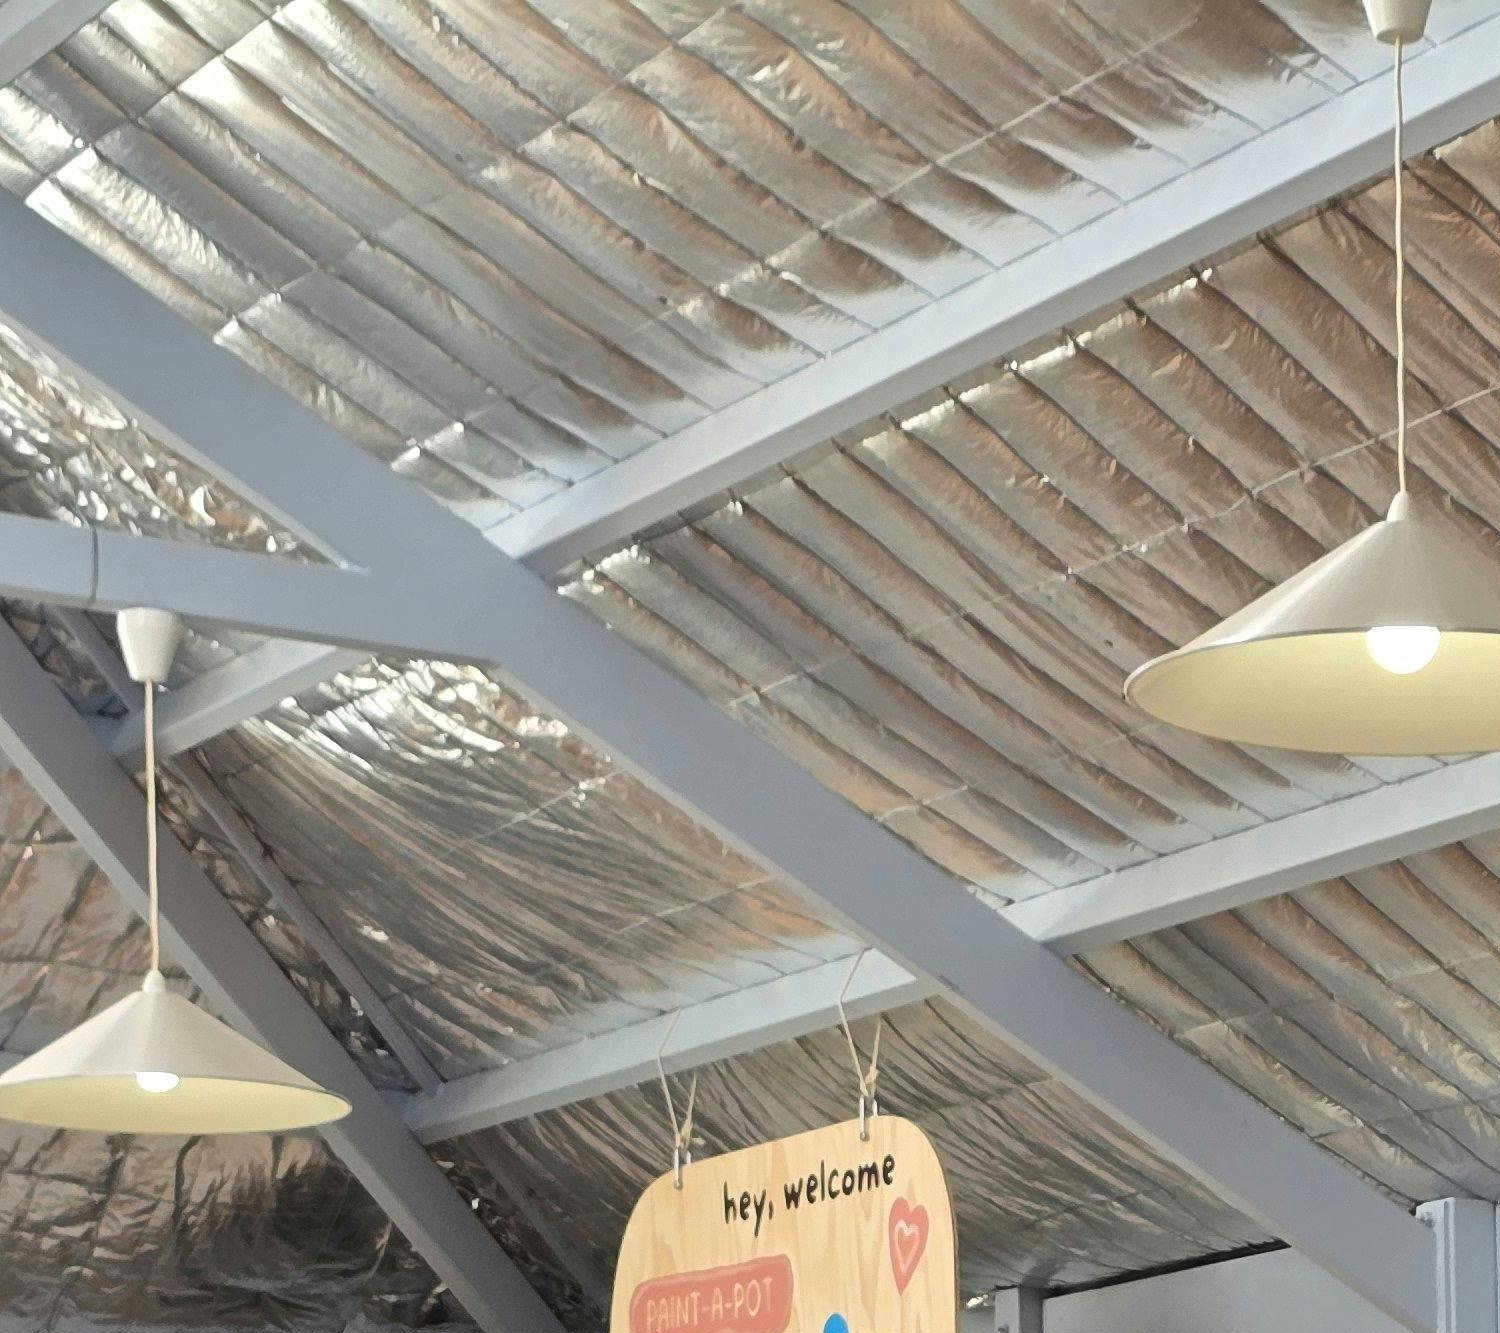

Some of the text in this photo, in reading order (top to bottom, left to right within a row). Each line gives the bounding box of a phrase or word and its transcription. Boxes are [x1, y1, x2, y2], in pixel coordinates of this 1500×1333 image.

[724, 1154, 895, 1238] hey, welcome
[646, 1277, 773, 1333] PAINT-A-POT
